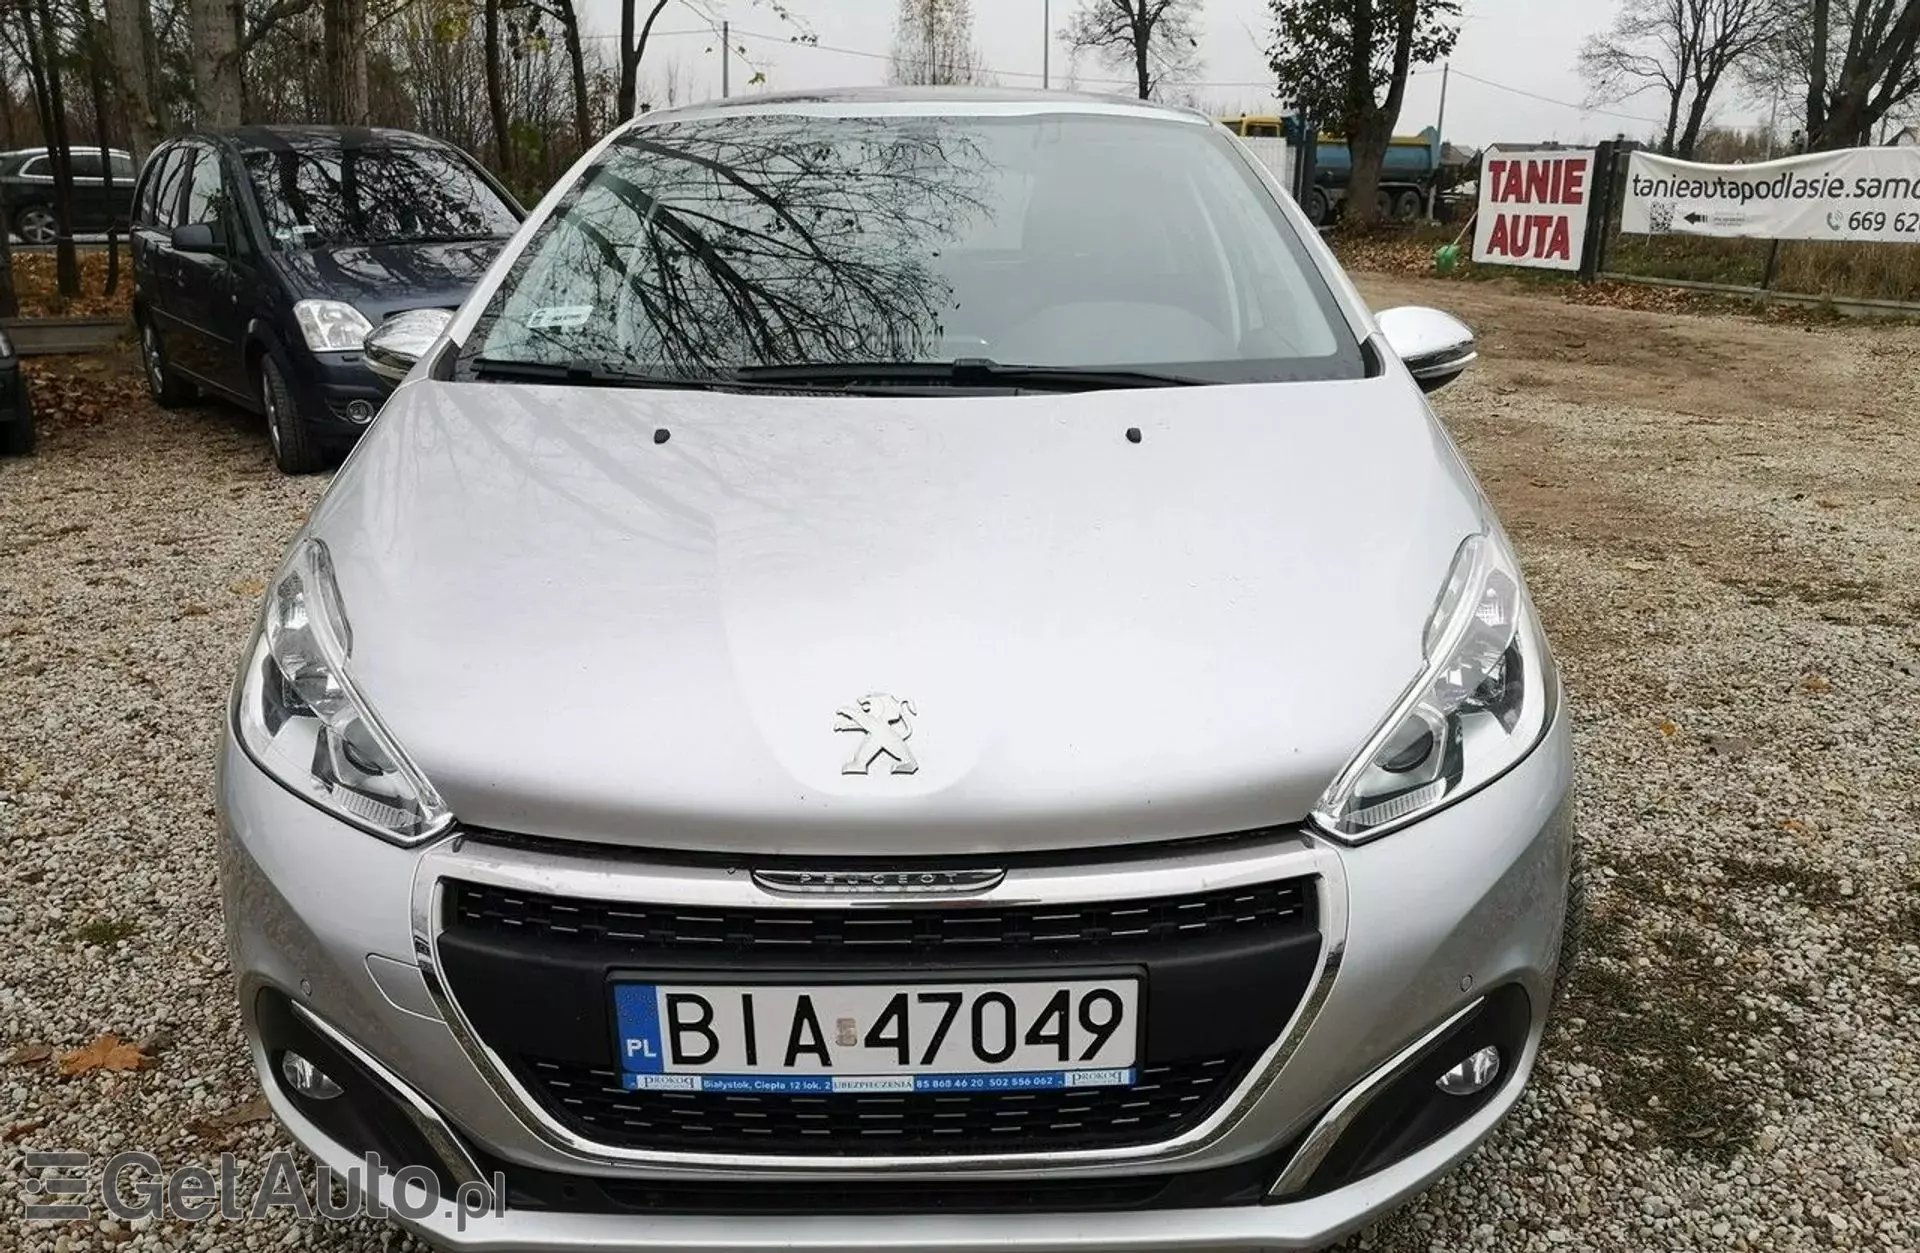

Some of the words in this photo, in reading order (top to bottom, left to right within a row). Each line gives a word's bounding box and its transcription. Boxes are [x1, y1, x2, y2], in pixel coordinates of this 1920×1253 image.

[1488, 159, 1587, 205] TANIE
[1848, 211, 1887, 231] 669
[1893, 211, 1920, 233] 62
[1486, 213, 1570, 260] AUTA
[800, 872, 958, 884] PEUGEOT
[665, 991, 833, 1068] BIA
[863, 987, 1125, 1067] 47049
[626, 1038, 657, 1058] PL
[970, 1078, 984, 1087] 20
